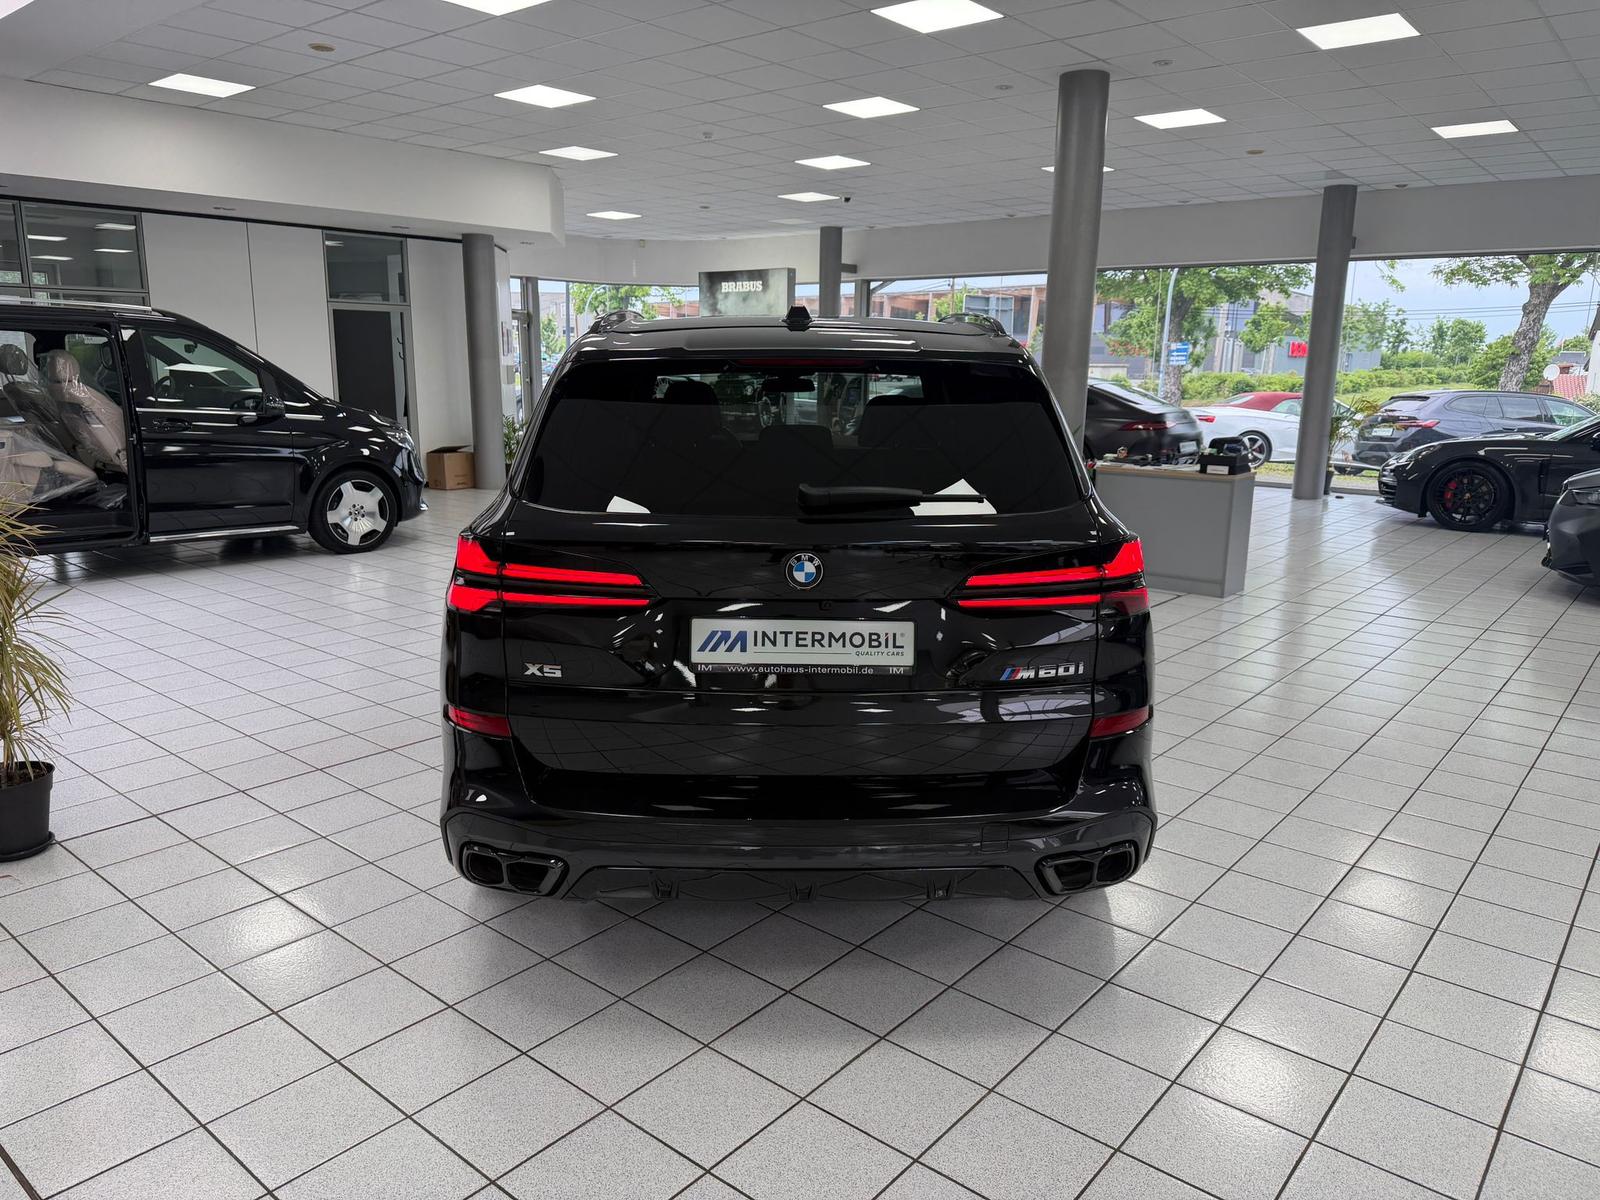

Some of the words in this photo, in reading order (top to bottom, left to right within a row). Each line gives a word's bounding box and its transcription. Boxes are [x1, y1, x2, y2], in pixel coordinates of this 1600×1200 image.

[721, 281, 763, 293] BRABUS
[523, 662, 562, 678] X5
[697, 664, 712, 672] IM
[727, 666, 874, 675] www.autohaus-intermobil.de
[889, 666, 904, 674] IM
